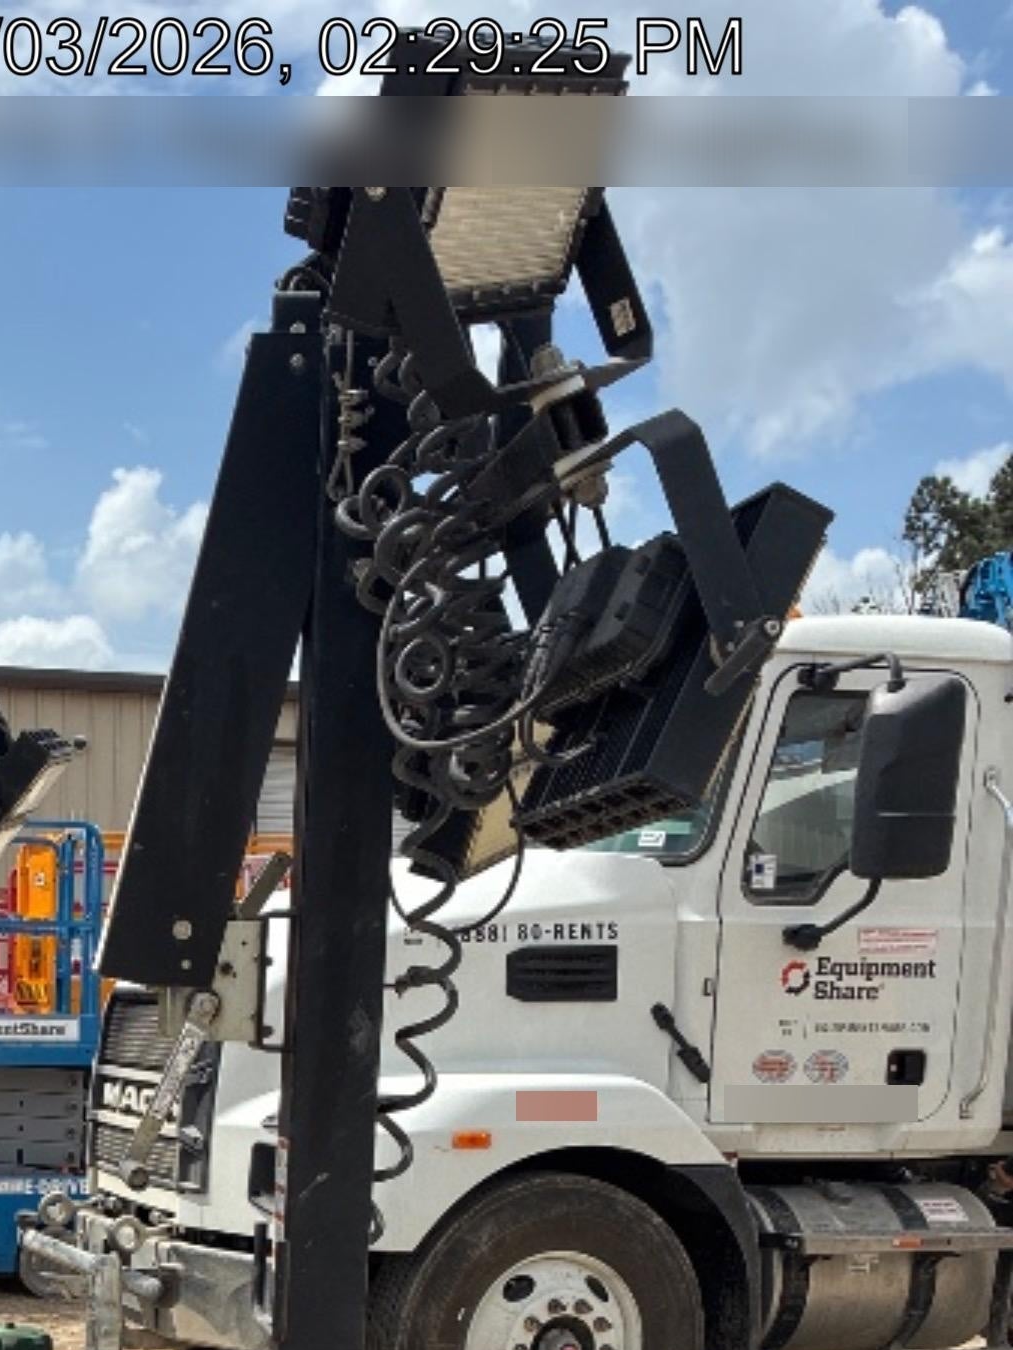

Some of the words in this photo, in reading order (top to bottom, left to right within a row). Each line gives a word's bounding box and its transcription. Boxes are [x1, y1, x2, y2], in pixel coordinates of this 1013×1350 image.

[517, 922, 619, 942] 80-RENTS
[815, 956, 937, 981] Equipment
[813, 981, 880, 1000] Share
[102, 1080, 178, 1118] MAC
